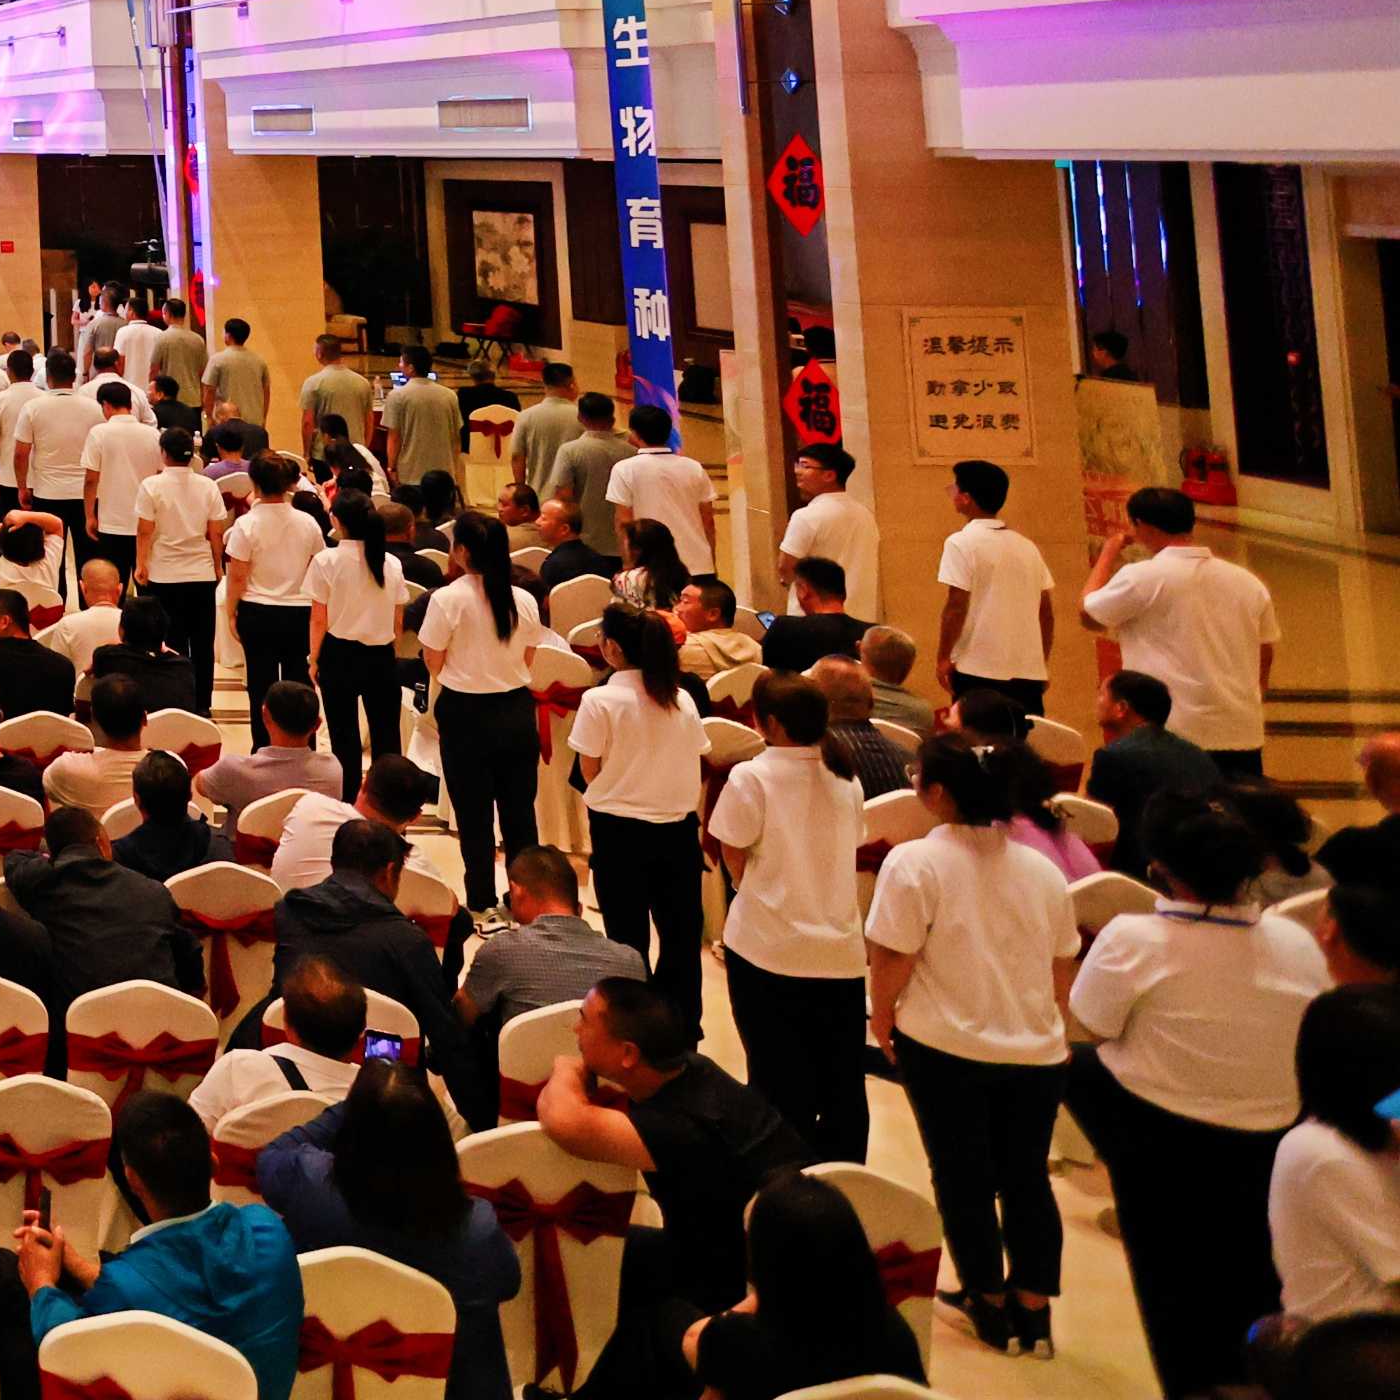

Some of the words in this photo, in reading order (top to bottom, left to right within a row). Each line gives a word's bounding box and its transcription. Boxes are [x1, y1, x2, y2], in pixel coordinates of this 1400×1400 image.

[782, 156, 821, 209] 福
[798, 378, 837, 437] 福
[929, 413, 1020, 430] 避免浪费
